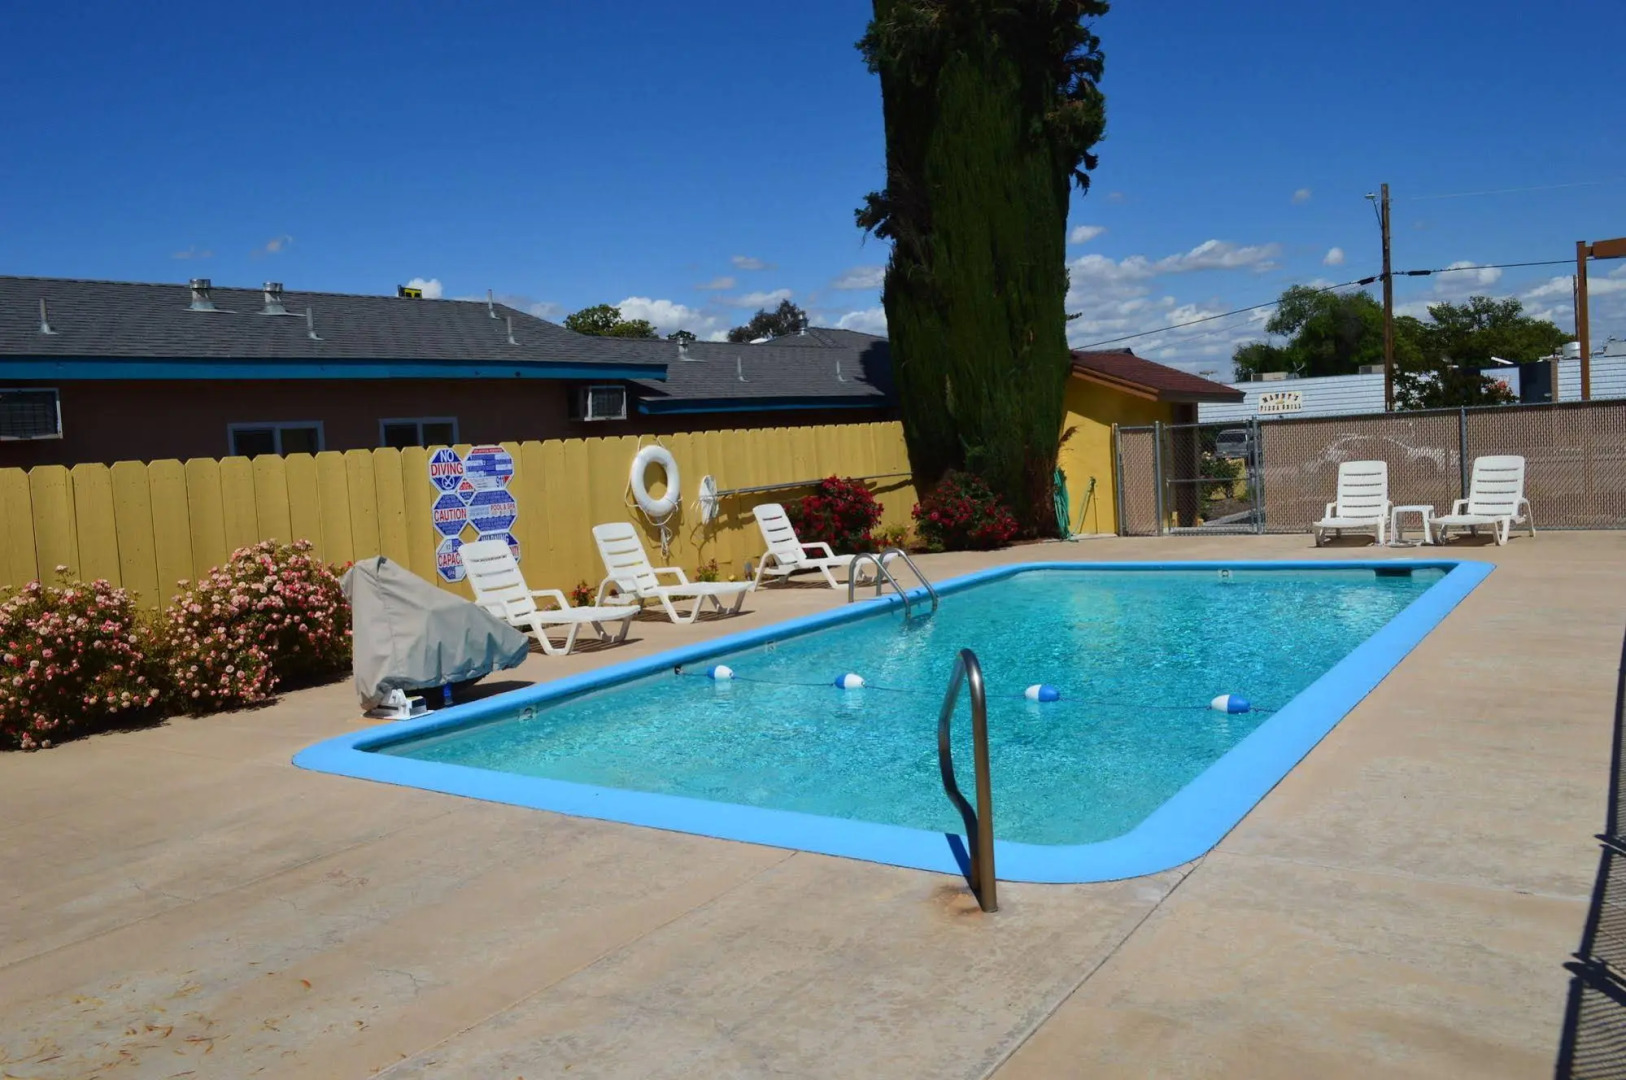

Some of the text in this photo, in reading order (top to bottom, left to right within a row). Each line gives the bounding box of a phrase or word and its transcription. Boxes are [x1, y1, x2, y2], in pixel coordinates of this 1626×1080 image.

[440, 449, 454, 462] NO
[430, 462, 463, 476] DIVING
[434, 508, 466, 522] CAUTION
[438, 552, 463, 567] CAPAC
